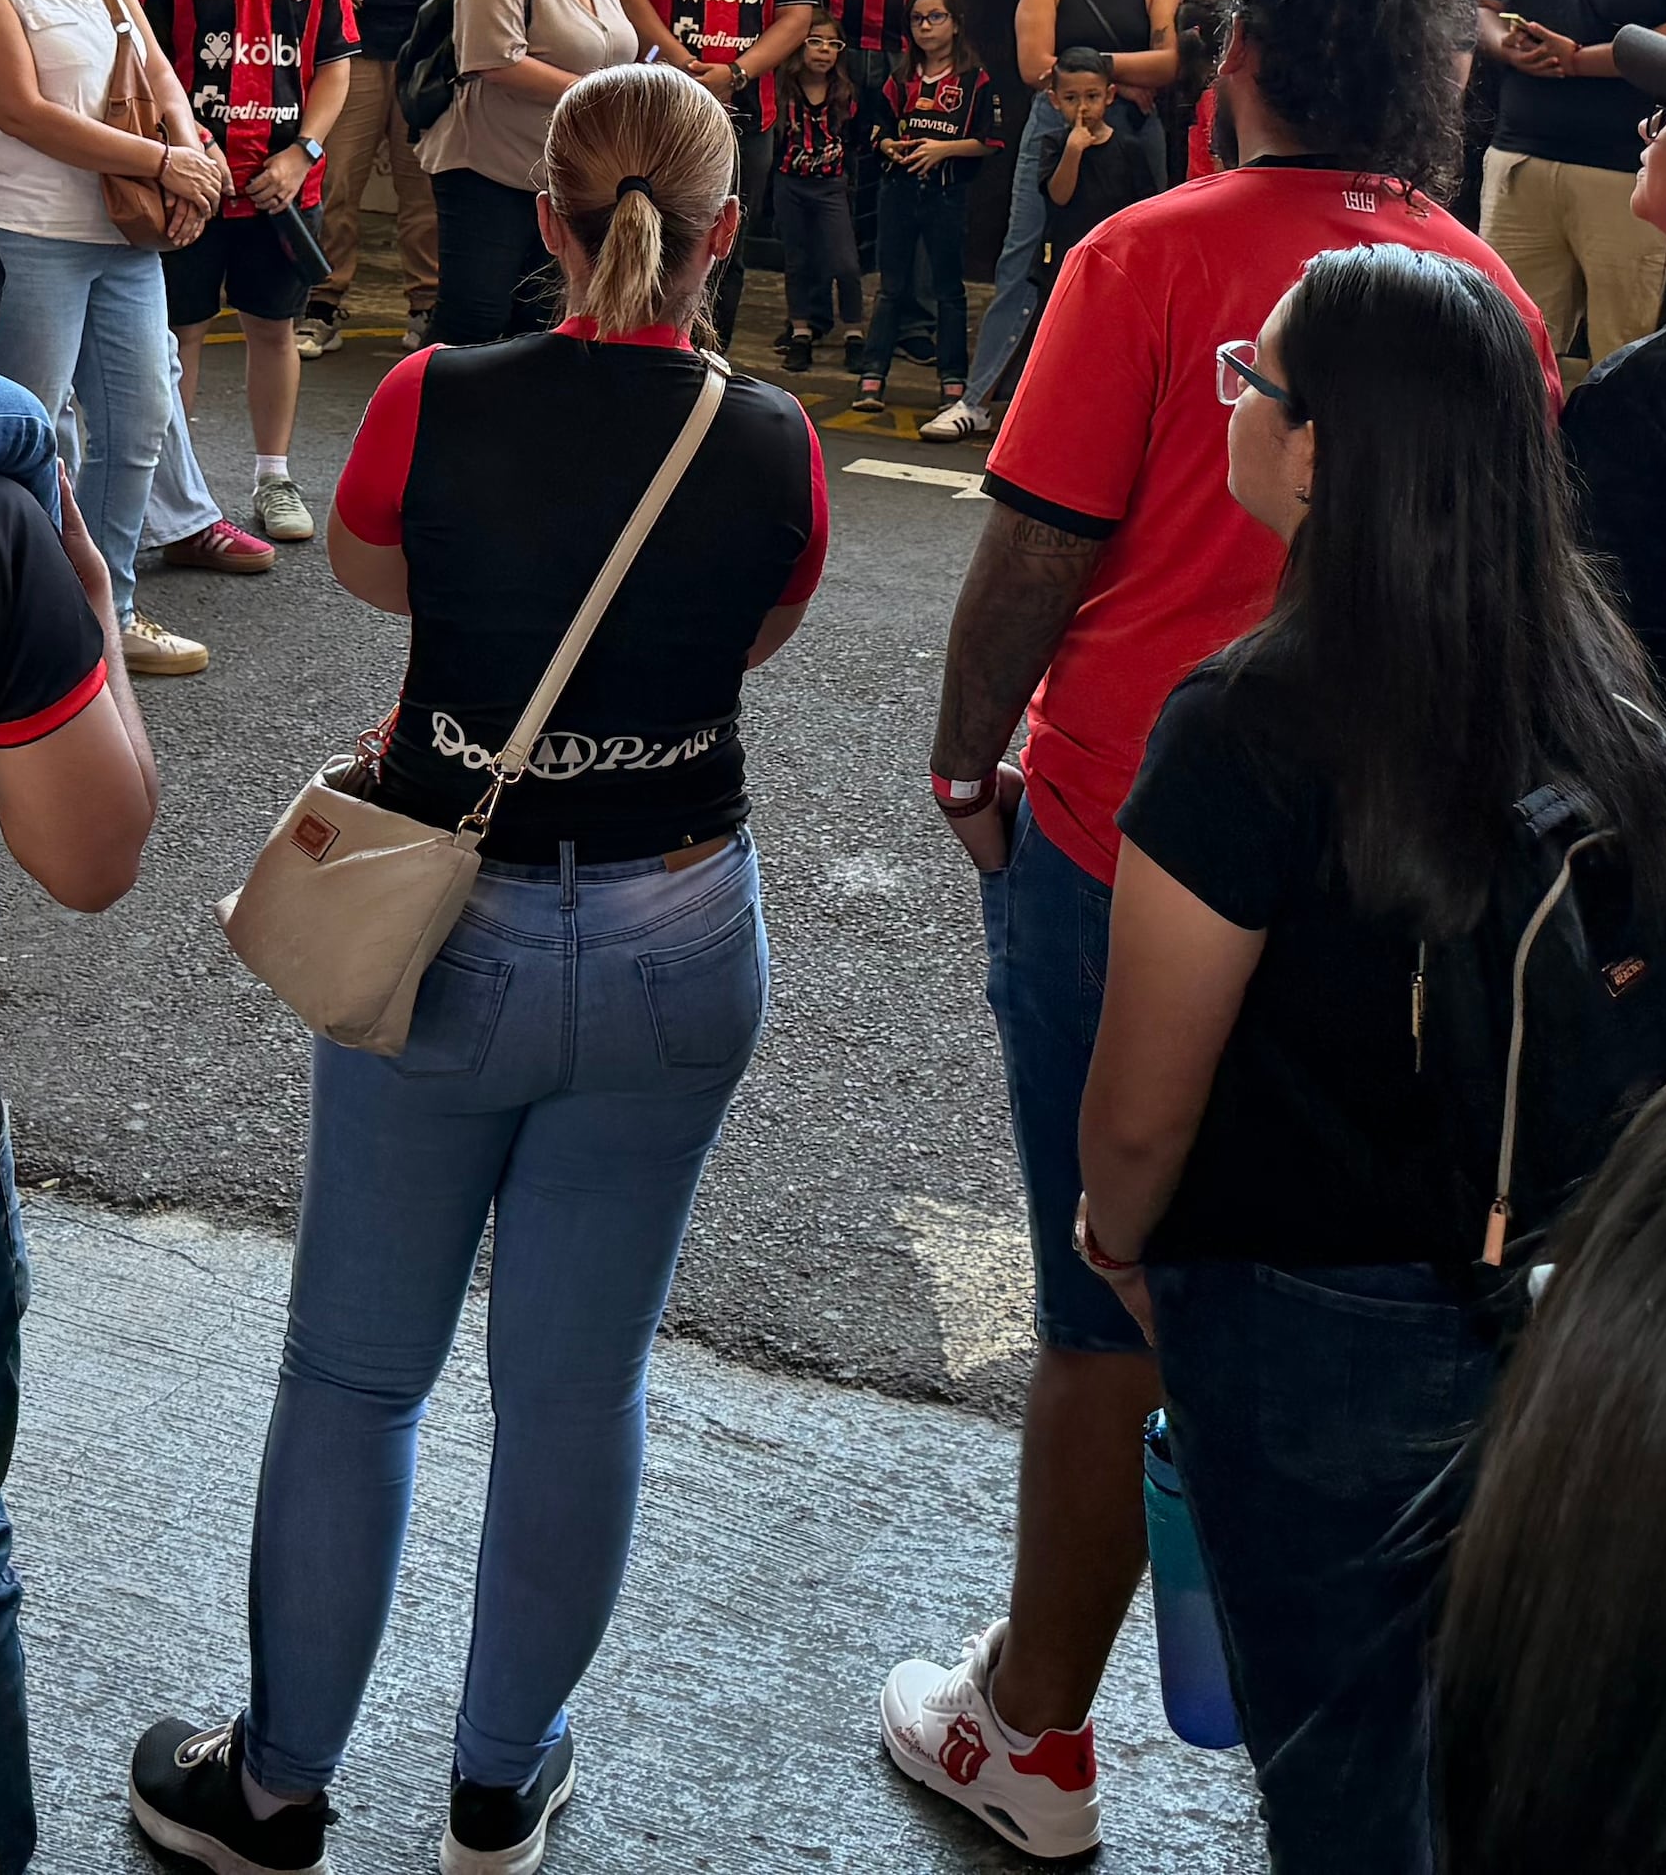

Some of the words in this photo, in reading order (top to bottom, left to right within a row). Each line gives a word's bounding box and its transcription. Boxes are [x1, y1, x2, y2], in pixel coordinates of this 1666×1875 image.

[235, 33, 301, 68] kölbi
[909, 116, 960, 135] movistar
[1341, 190, 1377, 214] 1919
[432, 711, 494, 770] Do
